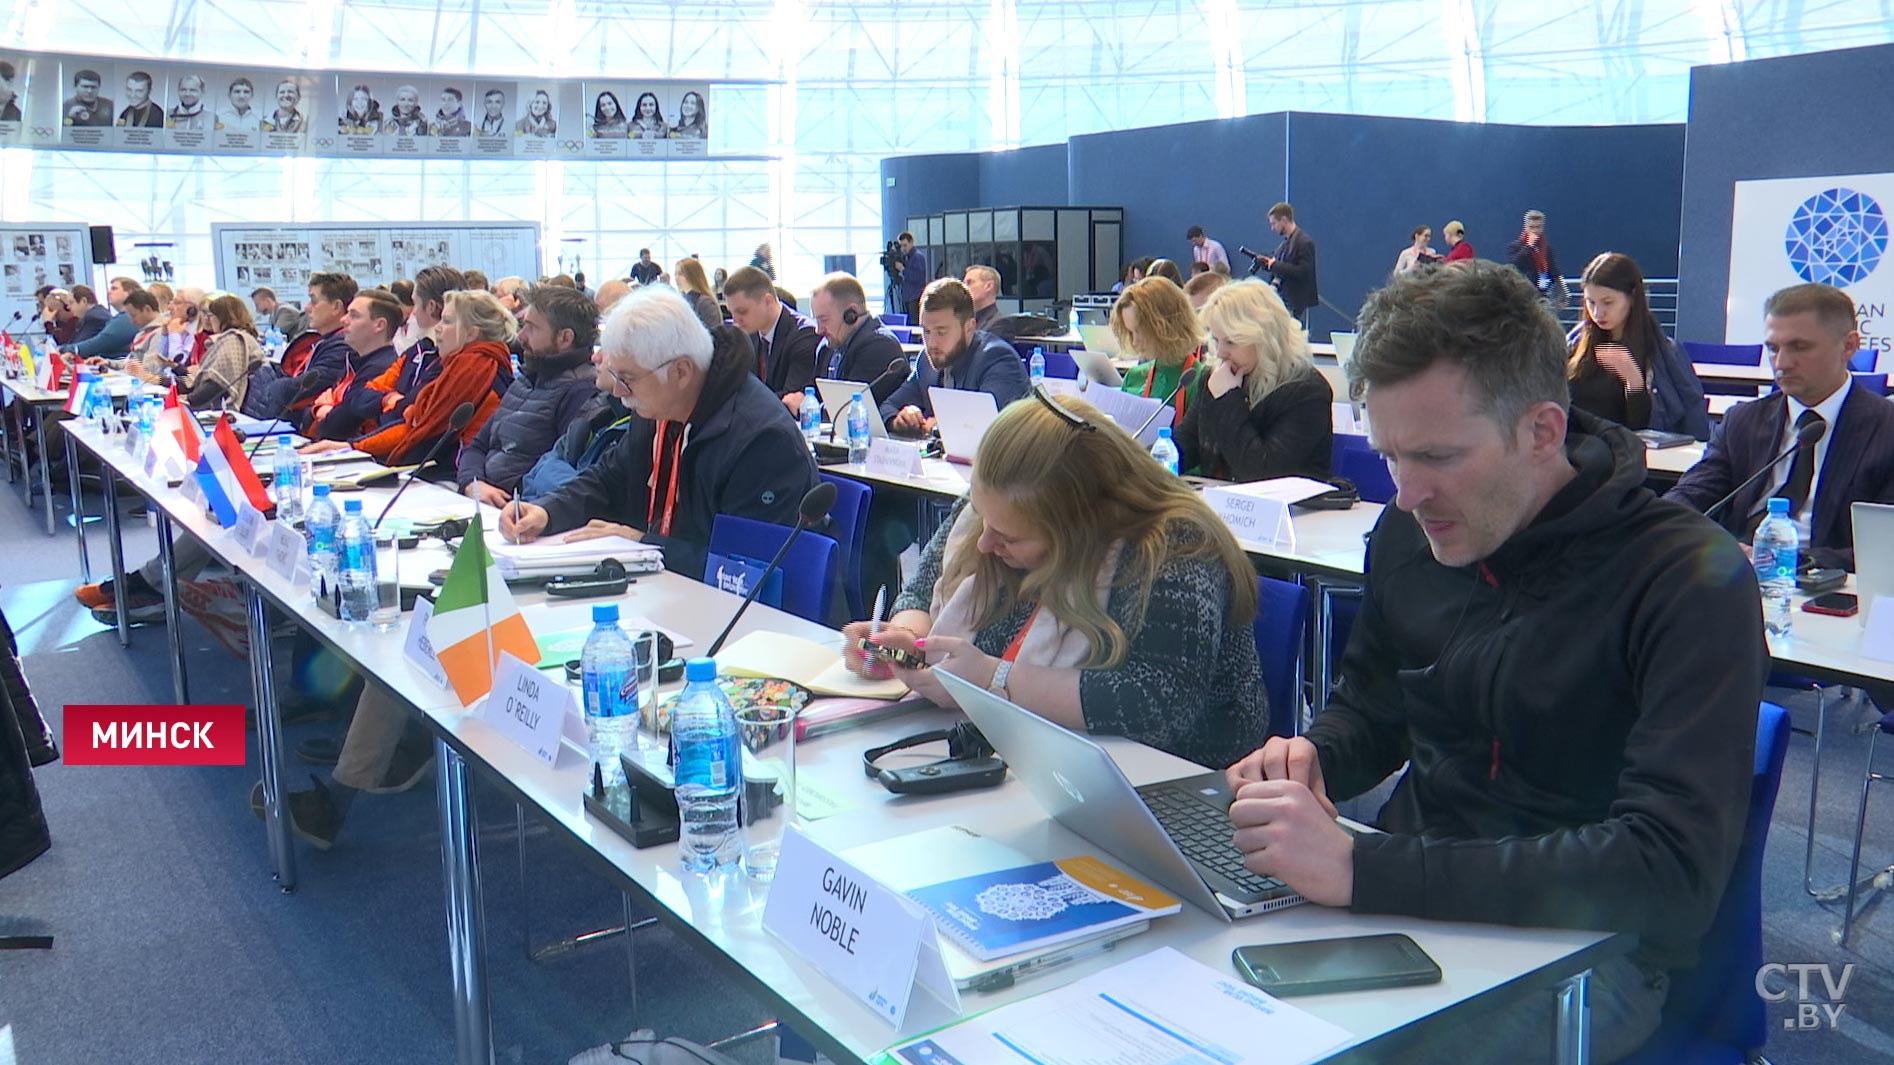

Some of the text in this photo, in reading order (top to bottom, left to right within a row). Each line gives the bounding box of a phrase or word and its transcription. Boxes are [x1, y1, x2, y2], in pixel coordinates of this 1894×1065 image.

[1225, 497, 1255, 513] SERGEI
[1221, 512, 1256, 529] HOMICH
[516, 673, 540, 703] LINDA
[821, 866, 868, 915] GAVIN
[809, 901, 861, 956] NOBLE
